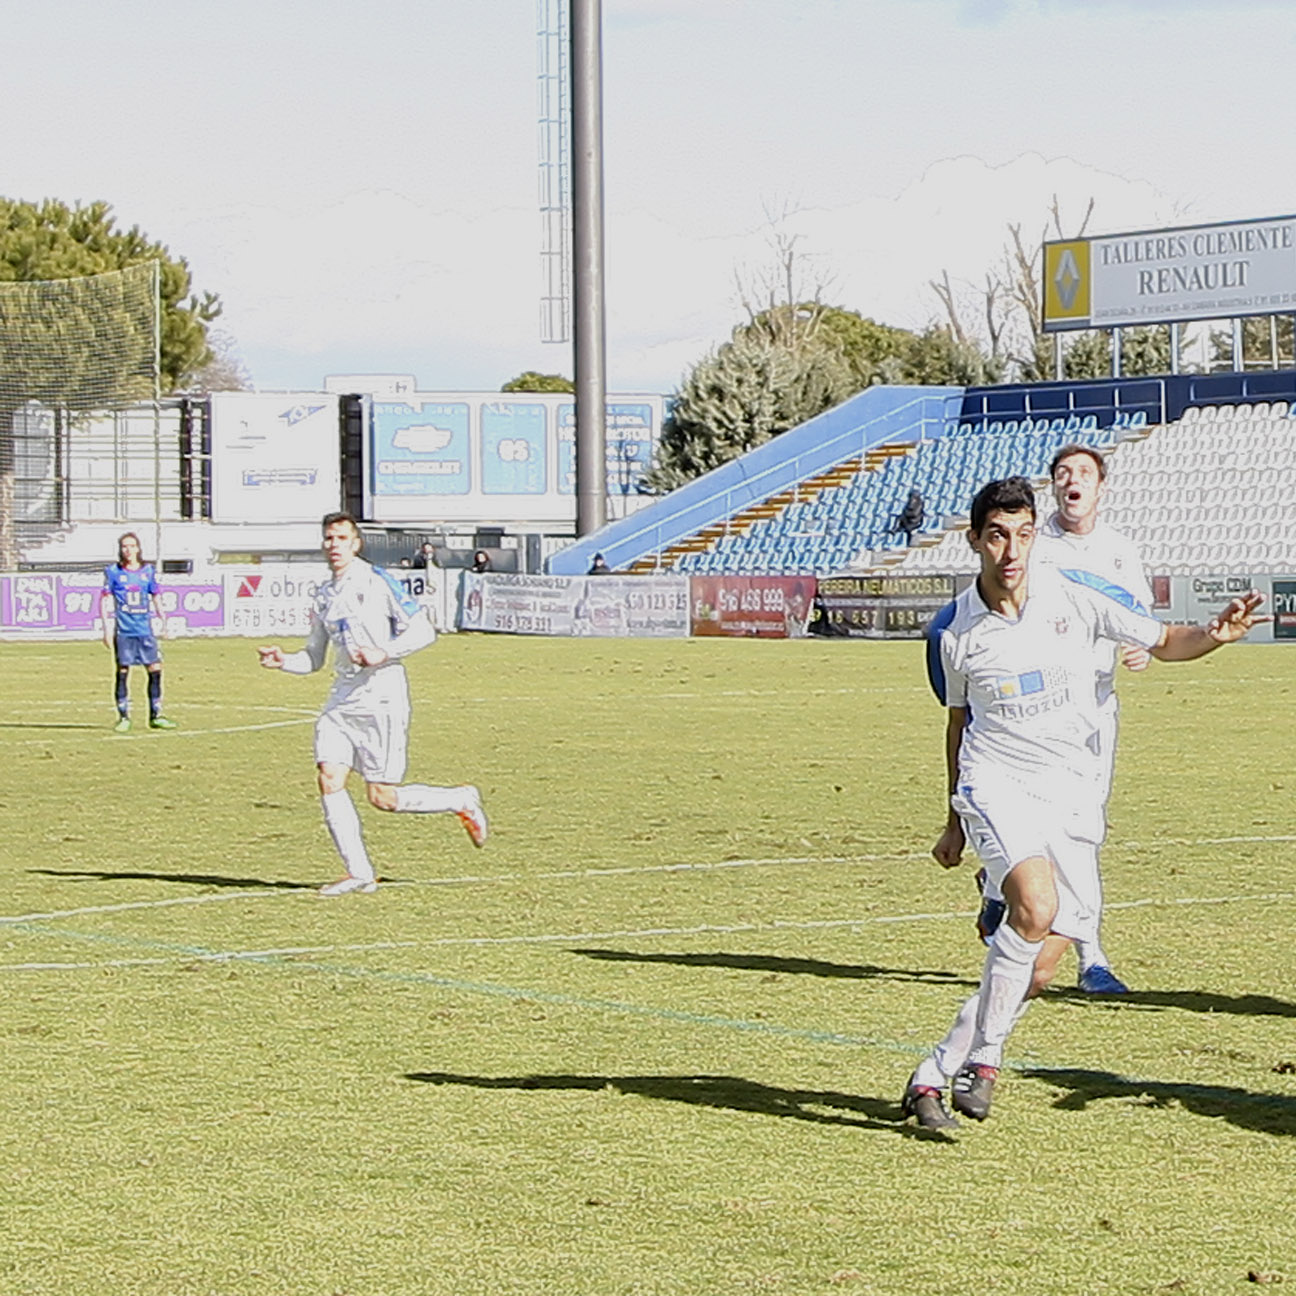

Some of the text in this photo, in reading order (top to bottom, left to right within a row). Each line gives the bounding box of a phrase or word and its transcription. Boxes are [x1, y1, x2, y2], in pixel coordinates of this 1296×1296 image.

[1101, 225, 1293, 265] TALLERES CLEMENTE
[1138, 260, 1250, 295] RENAULT
